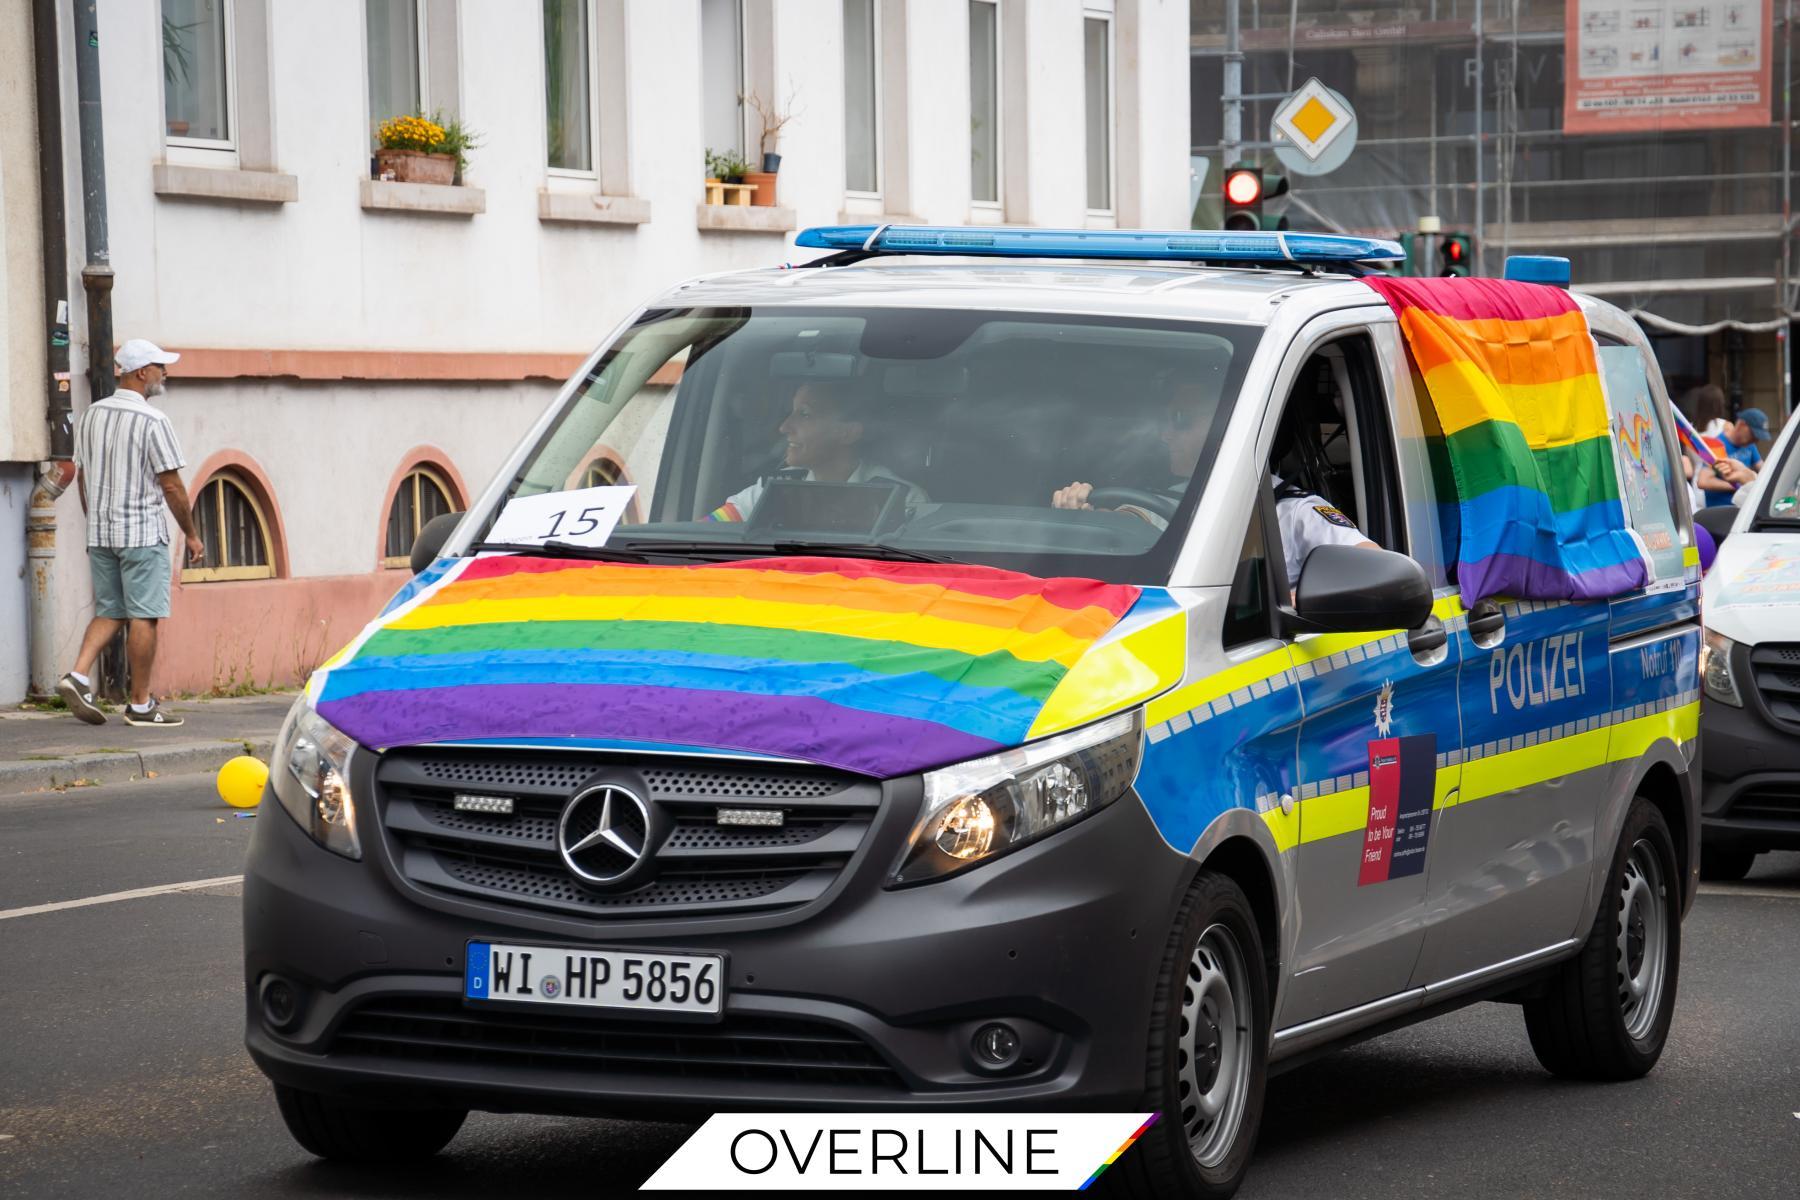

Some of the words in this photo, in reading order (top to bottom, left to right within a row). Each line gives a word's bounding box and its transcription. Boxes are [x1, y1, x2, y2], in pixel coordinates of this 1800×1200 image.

[538, 506, 605, 539] 15
[1489, 631, 1586, 714] POLIZEI
[1640, 641, 1668, 680] Notruf
[1669, 639, 1682, 672] 110
[1371, 805, 1387, 821] Proud
[1367, 830, 1374, 842] to
[1374, 829, 1381, 841] be
[1382, 827, 1394, 839] Your
[1365, 848, 1382, 863] Friend
[473, 976, 482, 989] D
[493, 950, 533, 994] WI
[565, 955, 611, 998] HP
[622, 959, 715, 1005] 5856
